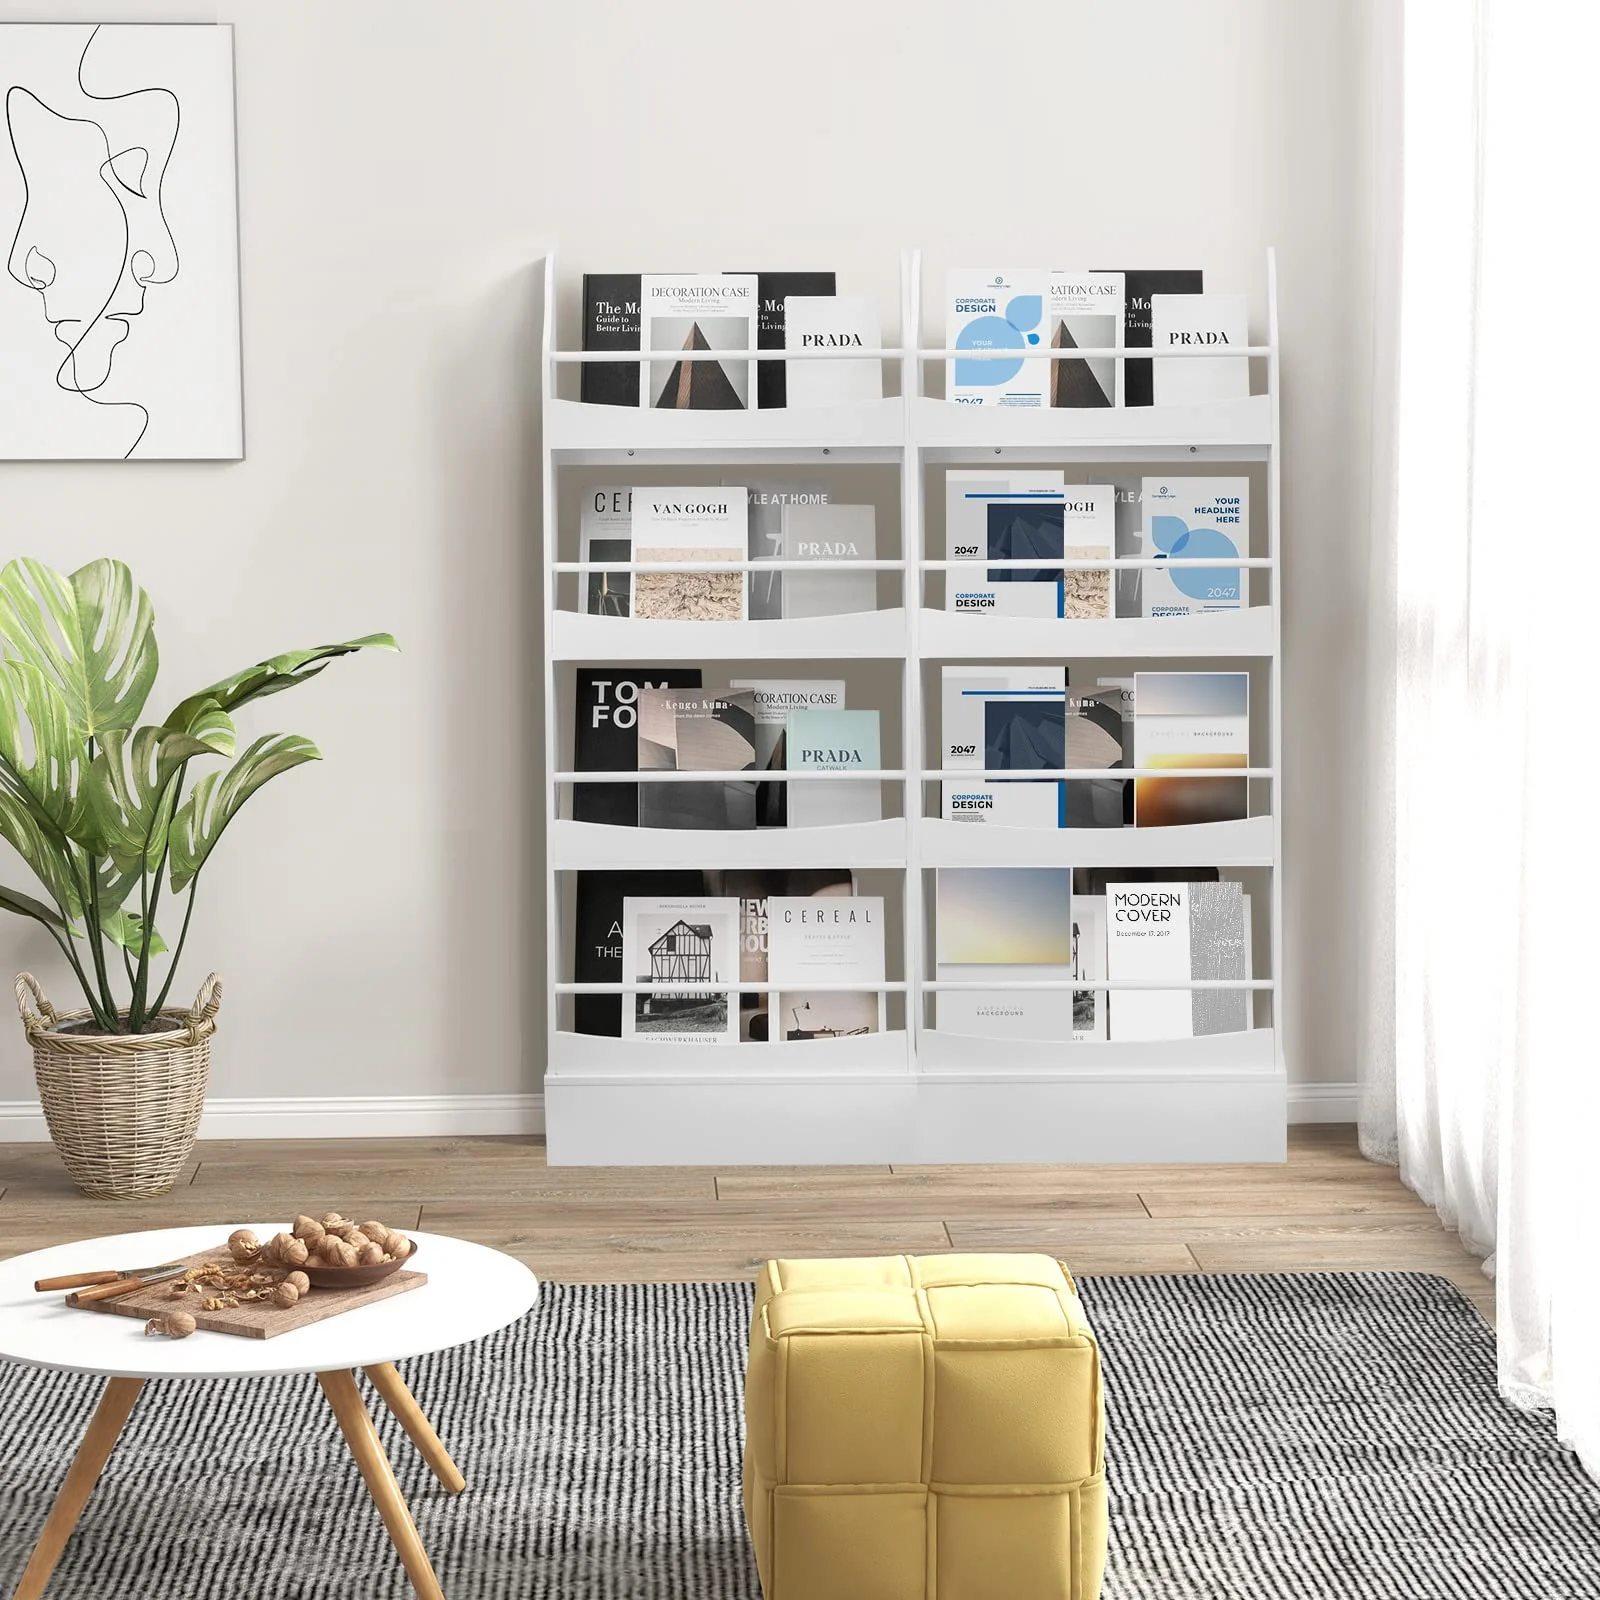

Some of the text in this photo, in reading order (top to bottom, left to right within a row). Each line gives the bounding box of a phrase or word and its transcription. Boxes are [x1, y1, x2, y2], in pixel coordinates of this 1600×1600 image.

[652, 287, 749, 297] DECORATION CASE
[1089, 285, 1117, 295] CASE
[596, 301, 621, 314] The
[764, 299, 784, 312] Mo
[955, 304, 996, 313] DESIGN
[1131, 297, 1151, 310] Mo
[596, 315, 620, 323] Guide
[596, 324, 620, 332] Better
[1128, 320, 1152, 330] Living
[802, 334, 863, 347] PRADA
[1169, 332, 1230, 345] PRADA
[771, 493, 788, 505] AT
[790, 493, 828, 505] HOME
[1215, 497, 1240, 505] YOUR
[653, 504, 728, 514] VAN GOGH
[798, 542, 859, 556] PRADA
[954, 546, 979, 554] 2047
[1207, 588, 1236, 598] 2047
[955, 599, 996, 607] DESIGN
[810, 693, 838, 704] CASE
[666, 700, 728, 710] Kengo Kuma
[592, 705, 637, 729] FO
[951, 745, 976, 754] 2047
[802, 750, 862, 763] PRADA
[952, 801, 993, 809] DESIGN
[1115, 893, 1181, 907] MODERN
[784, 910, 871, 923] CEREAL
[1116, 909, 1171, 922] COVER
[607, 920, 623, 939] A
[595, 946, 623, 958] THE
